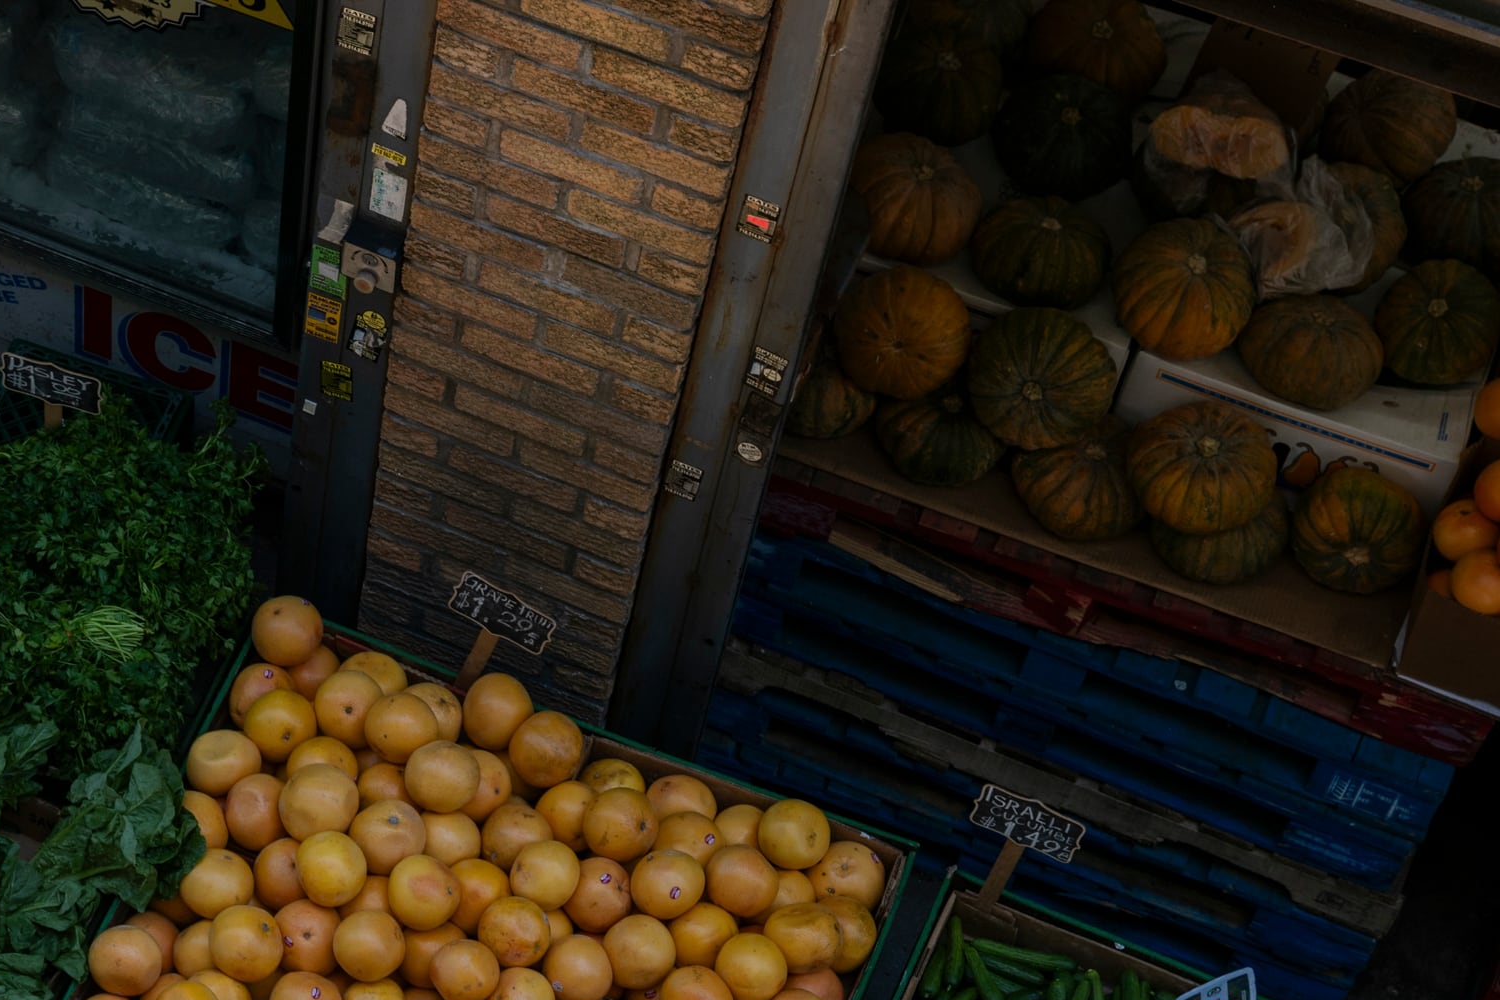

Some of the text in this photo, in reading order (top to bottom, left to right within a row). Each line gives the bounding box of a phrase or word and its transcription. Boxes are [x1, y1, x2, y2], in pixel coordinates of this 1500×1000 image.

[8, 357, 93, 391] PASLEY
[74, 284, 298, 434] ICE
[985, 786, 1071, 834] ISRAELI
[980, 815, 1062, 852] $1.49
